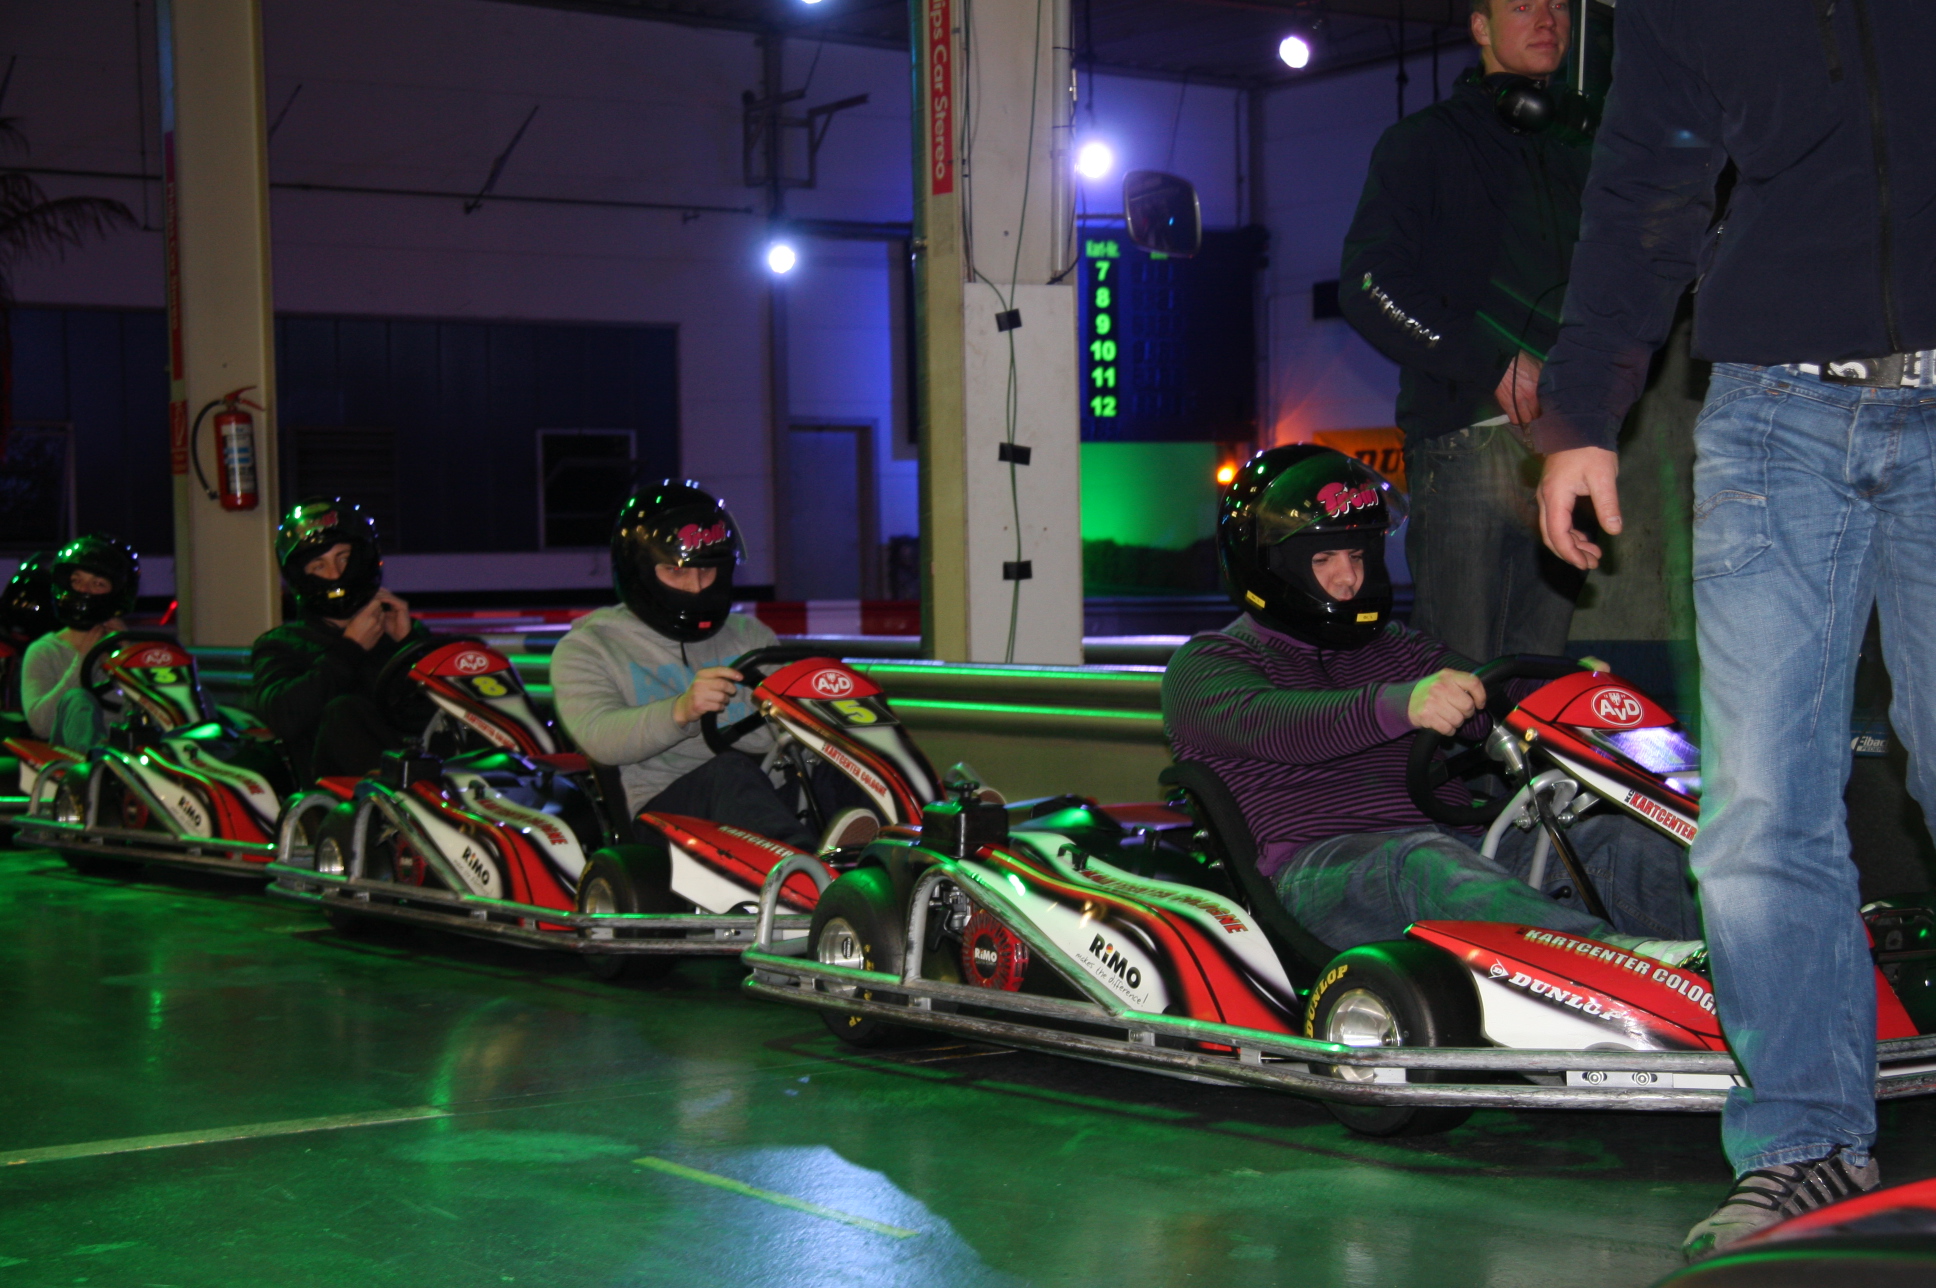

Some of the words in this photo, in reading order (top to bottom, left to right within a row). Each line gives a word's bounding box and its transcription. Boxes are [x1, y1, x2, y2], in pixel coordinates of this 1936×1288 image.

[932, 44, 947, 91] Car
[933, 95, 949, 180] Stereo
[1095, 260, 1111, 281] 7
[1095, 286, 1111, 308] 8
[1095, 313, 1111, 335] 9
[1089, 339, 1118, 361] 10
[1091, 366, 1117, 388] 11
[1090, 395, 1118, 417] 12
[150, 666, 178, 684] 3
[471, 675, 508, 697] 8
[831, 699, 878, 724] 5
[1629, 792, 1698, 842] KARTCENTER
[1524, 928, 1651, 975] KARTCENTER
[1652, 967, 1718, 1017] COLOG
[1306, 964, 1349, 1039] DUNLOP
[1507, 971, 1625, 1022] DUNLOP
